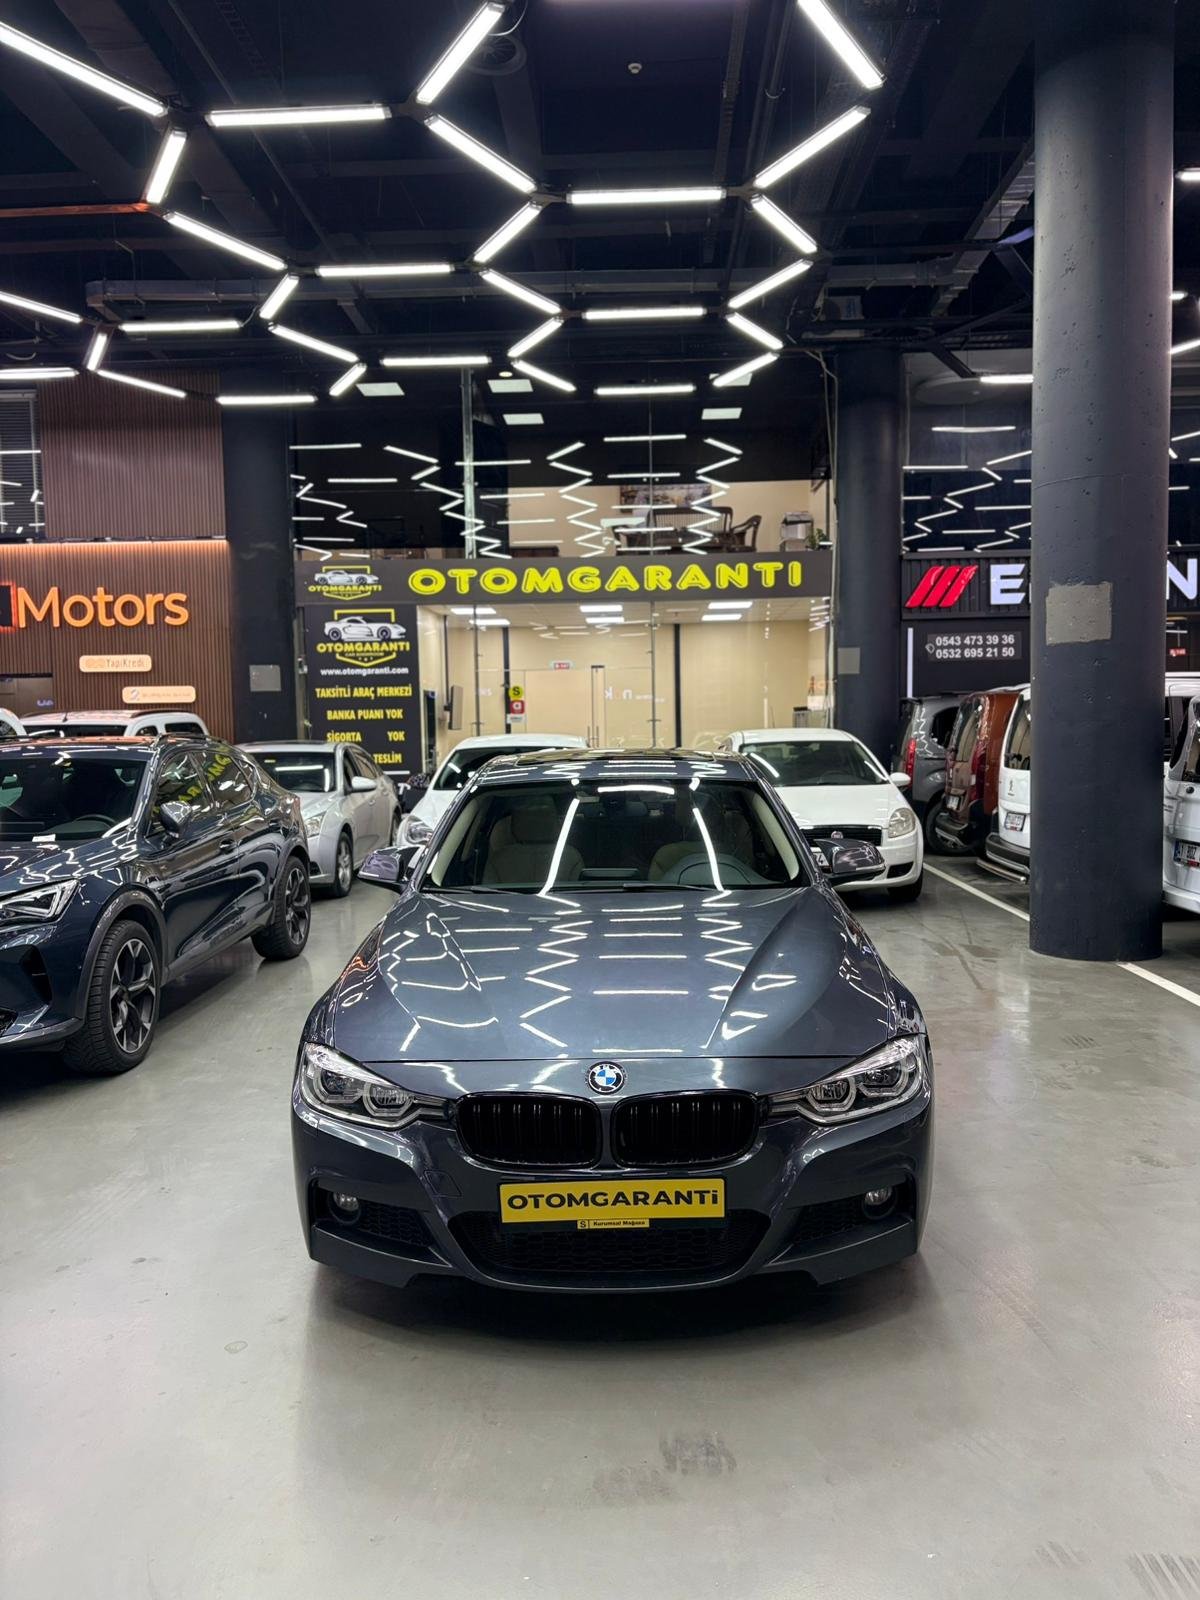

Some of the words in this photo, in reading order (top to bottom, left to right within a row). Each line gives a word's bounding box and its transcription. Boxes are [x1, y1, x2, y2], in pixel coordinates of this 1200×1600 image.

[407, 561, 802, 595] OTOMGARANTI
[17, 586, 189, 628] Motors
[935, 636, 961, 646] 0543
[963, 635, 983, 645] 473
[986, 634, 999, 645] 39
[1001, 634, 1015, 644] 36
[316, 641, 410, 653] OTOMGARANTI
[935, 648, 961, 659] 0532
[963, 647, 983, 658] 695
[986, 647, 998, 657] 21
[1001, 647, 1015, 657] 50
[320, 667, 409, 677] www.otomgaranti.com
[315, 684, 351, 698] TAKSİTLİ
[353, 686, 375, 700] ARAÇ
[377, 683, 412, 697] MERKEZİ
[326, 710, 356, 720] BANKA
[357, 709, 384, 720] PUANI
[385, 708, 403, 719] YOK
[326, 730, 362, 742] SİGORTA
[387, 731, 405, 741] YOK
[373, 750, 402, 764] TESLİM
